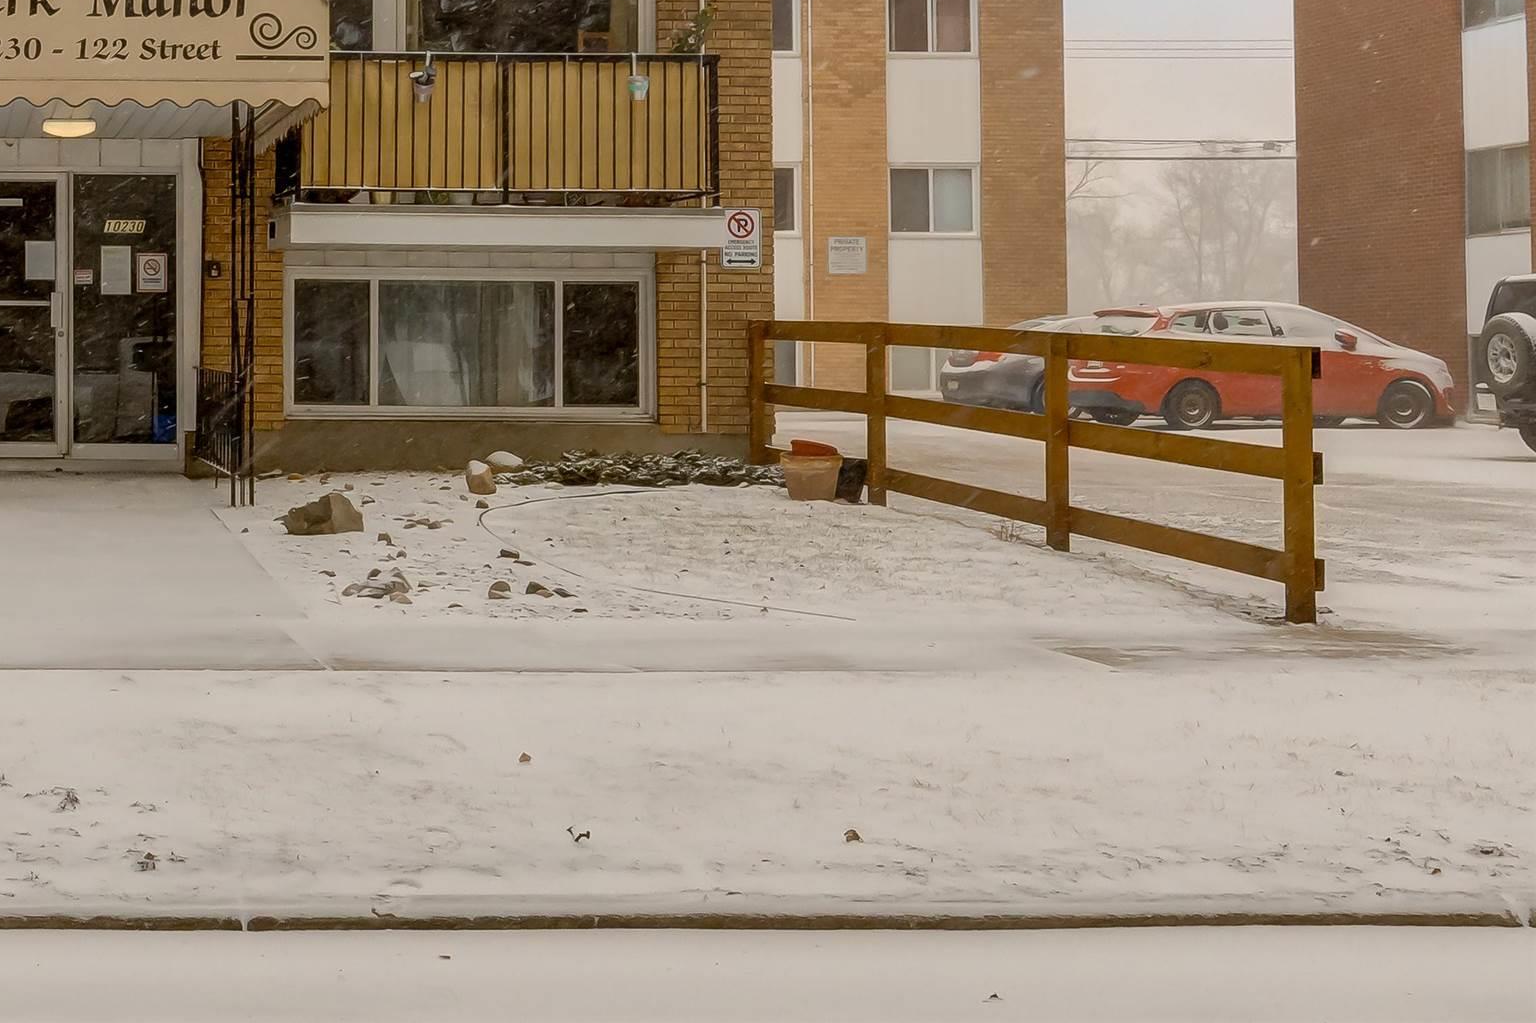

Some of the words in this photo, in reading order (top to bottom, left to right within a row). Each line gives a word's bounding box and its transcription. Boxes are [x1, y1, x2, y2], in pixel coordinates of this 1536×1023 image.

[75, 37, 130, 60] 122
[138, 37, 223, 61] Street
[106, 220, 145, 233] 10230
